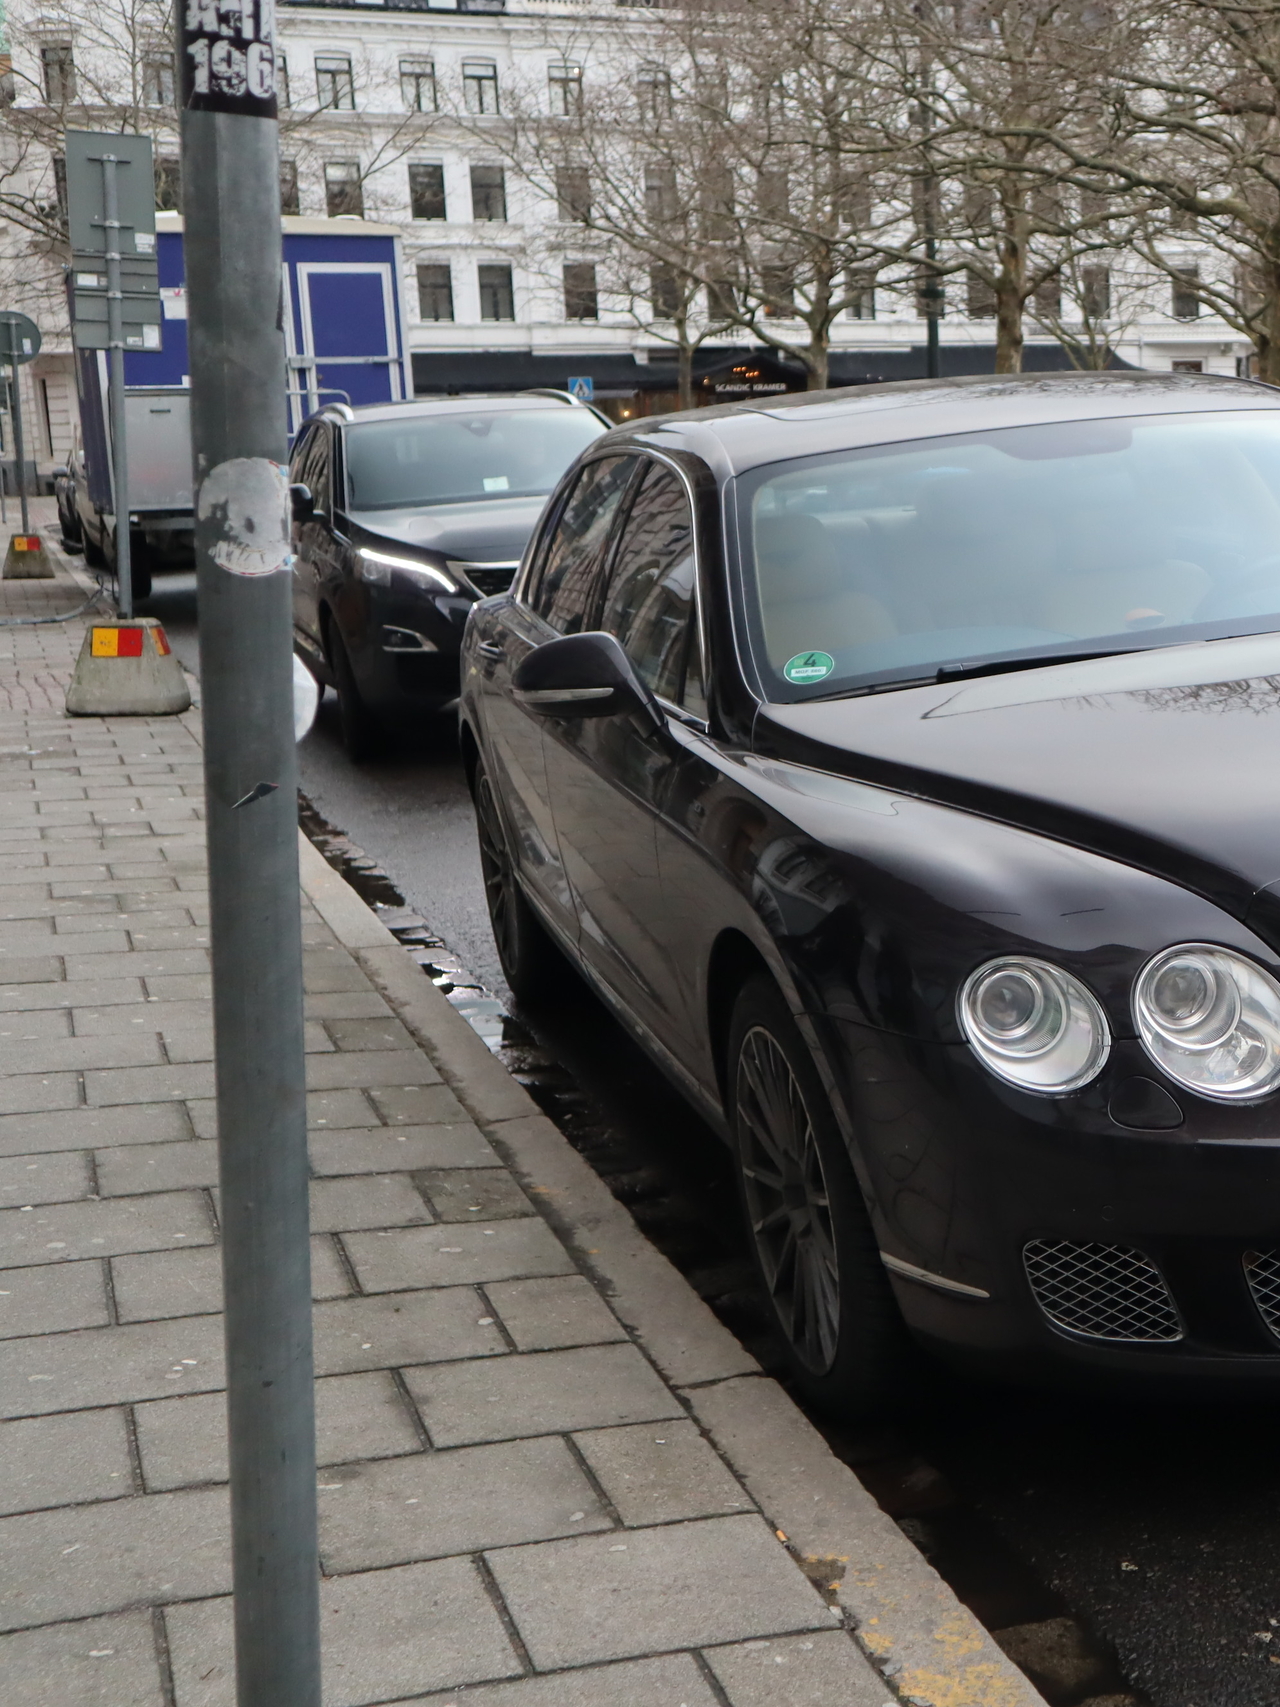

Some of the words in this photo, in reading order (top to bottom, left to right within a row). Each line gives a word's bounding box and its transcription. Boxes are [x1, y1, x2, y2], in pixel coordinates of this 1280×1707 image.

[715, 383, 750, 392] SCANDIC
[753, 383, 786, 391] KRAMER
[803, 653, 817, 667] 4
